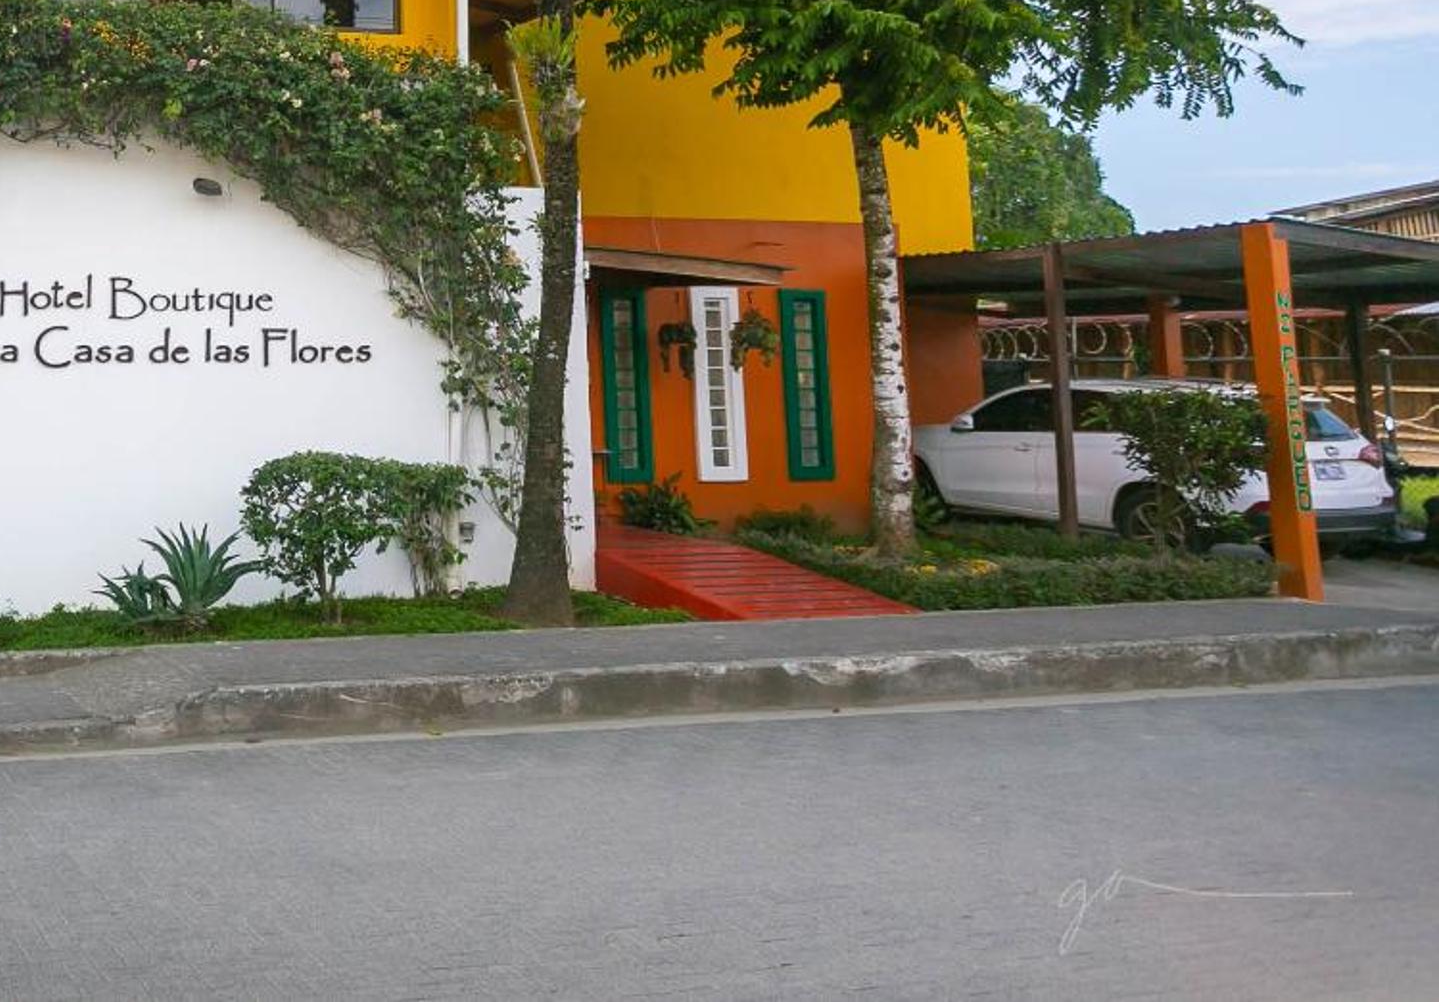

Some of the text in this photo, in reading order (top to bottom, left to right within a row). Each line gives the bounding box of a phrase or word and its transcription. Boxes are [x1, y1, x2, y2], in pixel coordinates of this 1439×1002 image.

[108, 276, 274, 327] Boutique
[33, 325, 134, 369] Casa
[148, 327, 190, 364] de
[204, 327, 250, 364] las
[261, 327, 373, 368] Flores
